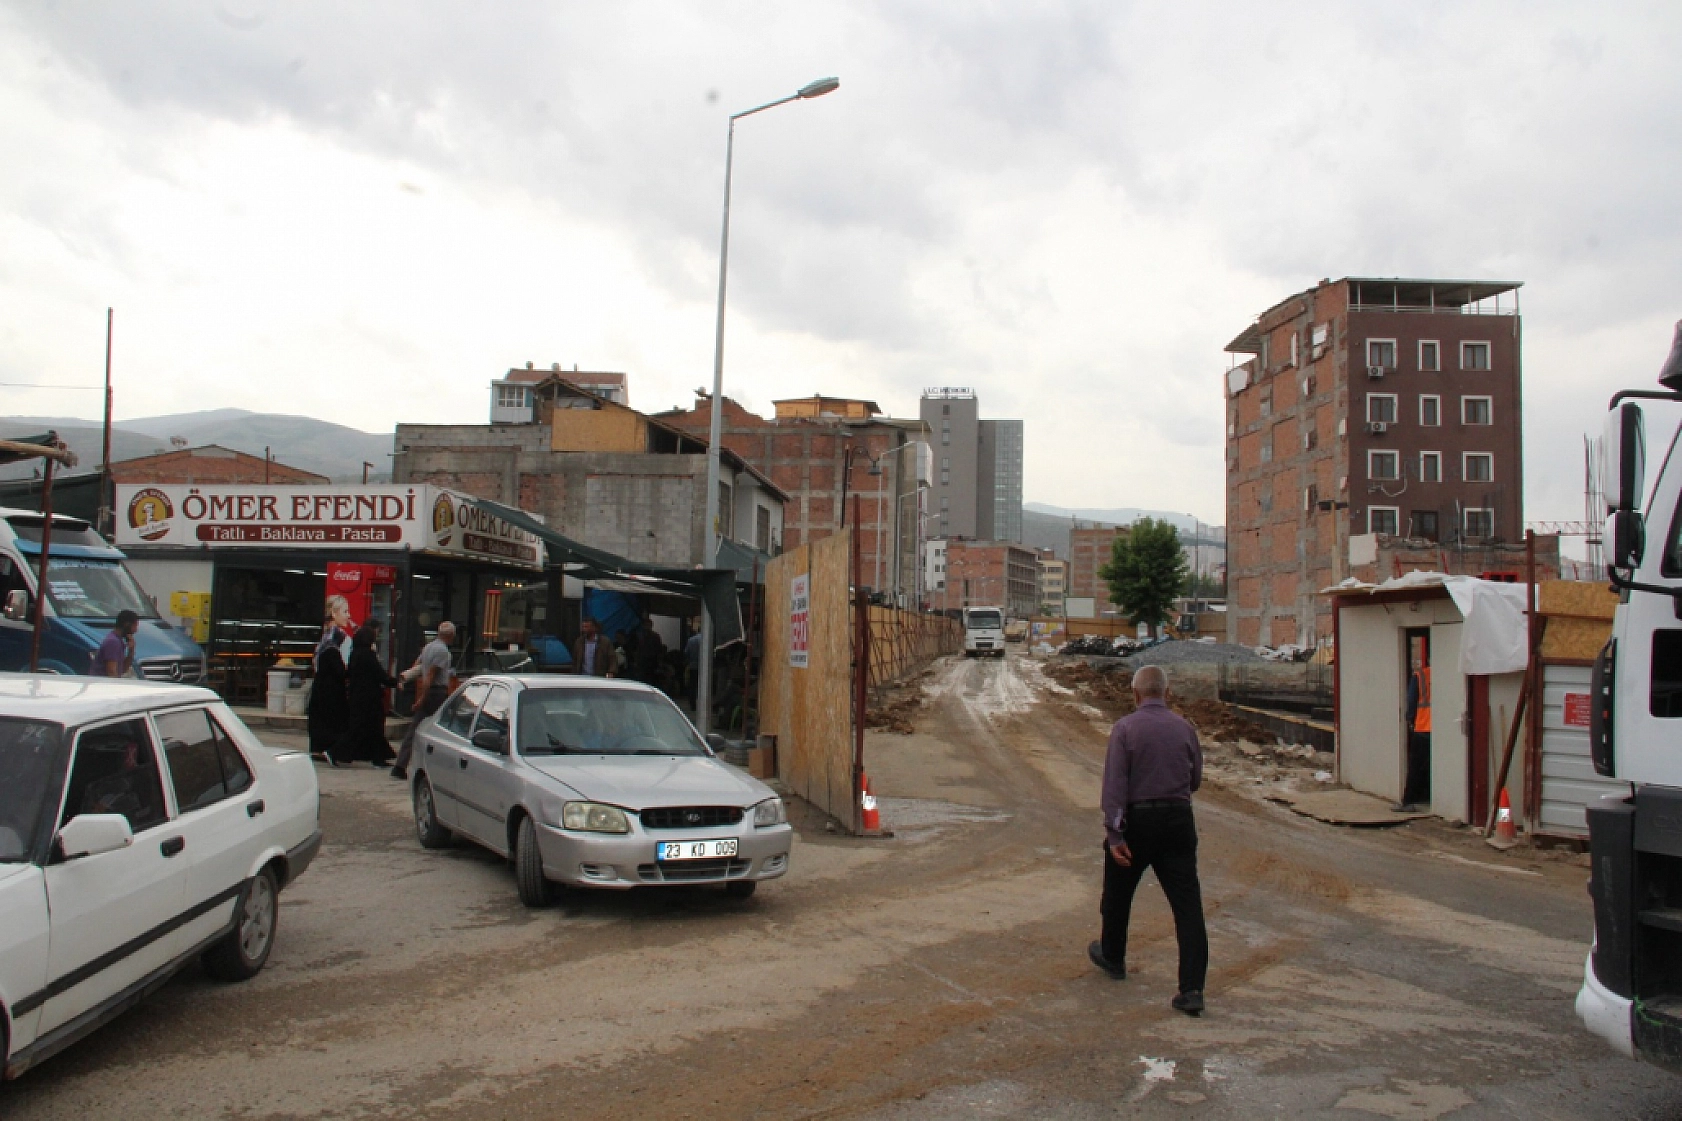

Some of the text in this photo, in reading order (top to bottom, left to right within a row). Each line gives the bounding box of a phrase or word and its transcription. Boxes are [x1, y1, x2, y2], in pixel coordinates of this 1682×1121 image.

[182, 488, 280, 520] ÖMER
[290, 488, 416, 520] EFENDİ
[210, 526, 245, 540] Tatlı
[261, 526, 325, 540] Baklava
[341, 527, 386, 541] Pasta
[666, 844, 681, 858] 23
